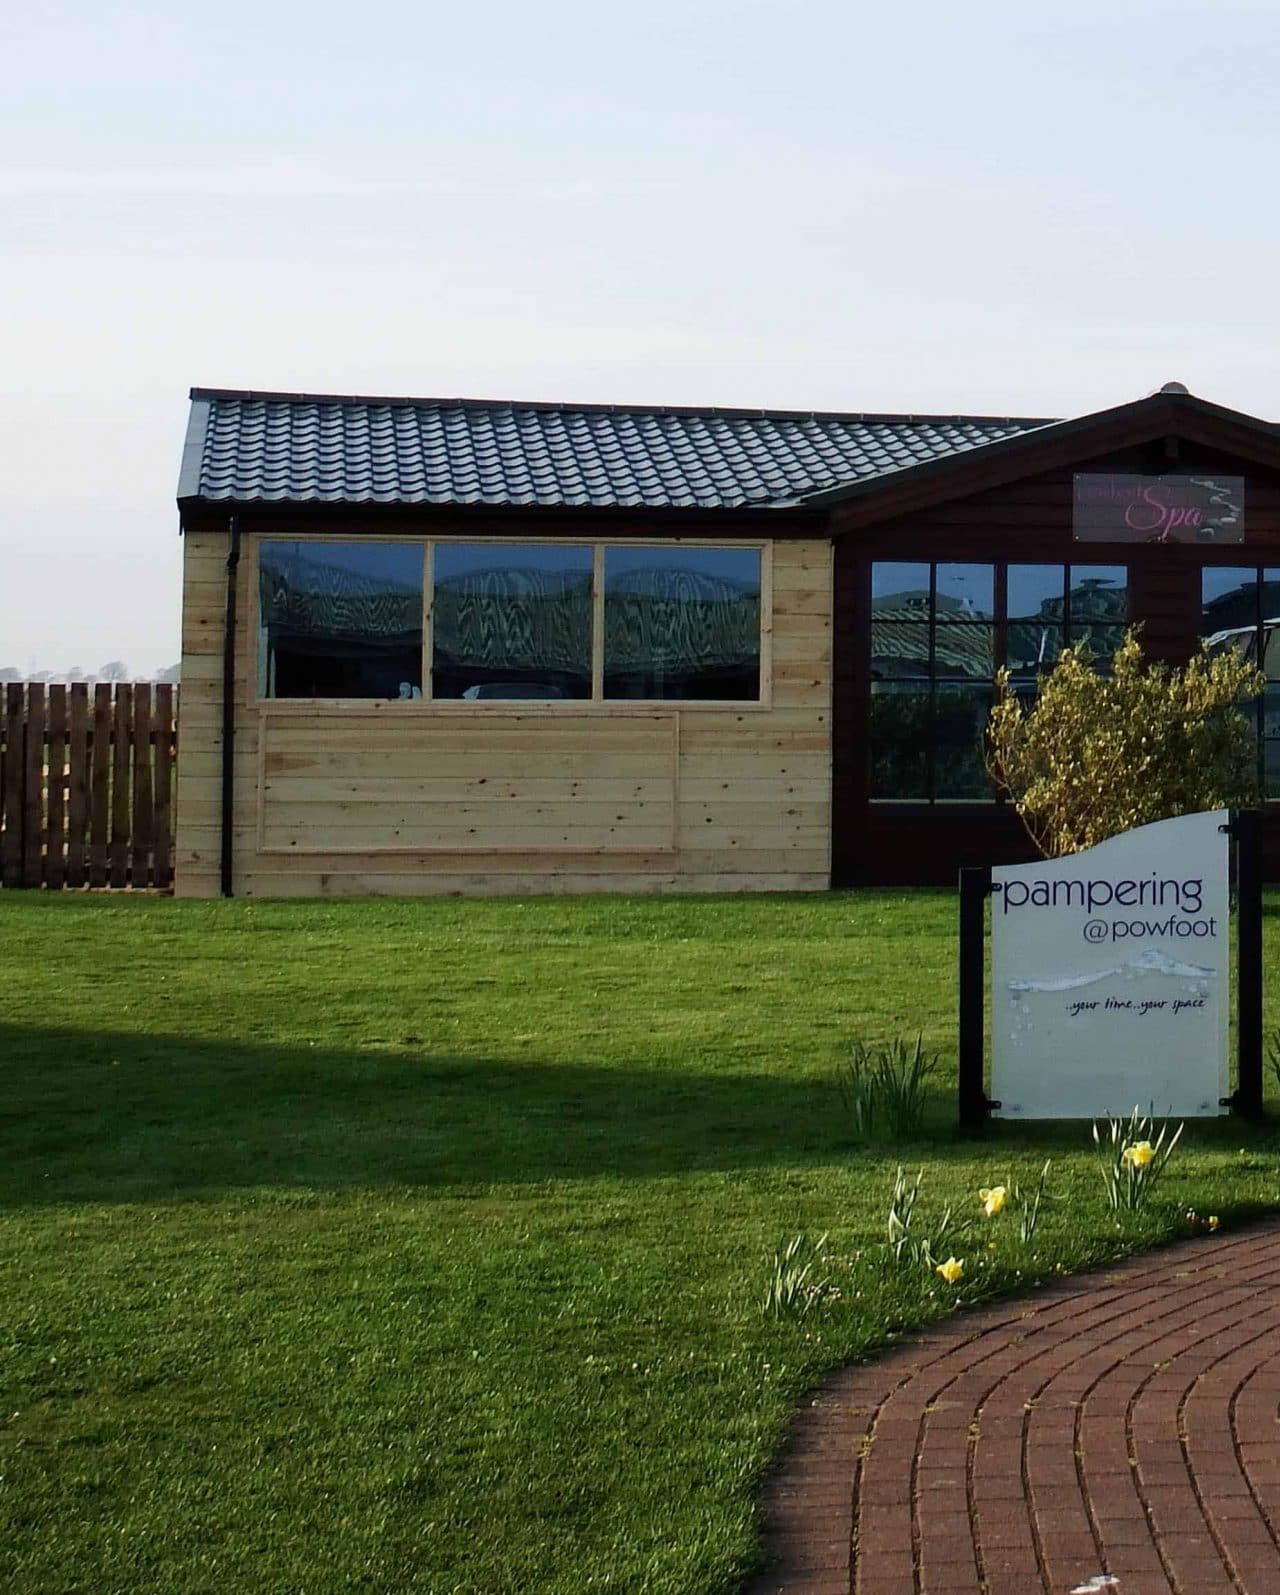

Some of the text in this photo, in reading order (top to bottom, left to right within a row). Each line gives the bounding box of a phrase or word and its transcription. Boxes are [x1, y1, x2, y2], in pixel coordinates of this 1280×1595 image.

[1125, 485, 1202, 541] Spa
[1003, 872, 1203, 914] pampering
[1083, 916, 1217, 944] @powfoot
[1171, 999, 1206, 1015] space
